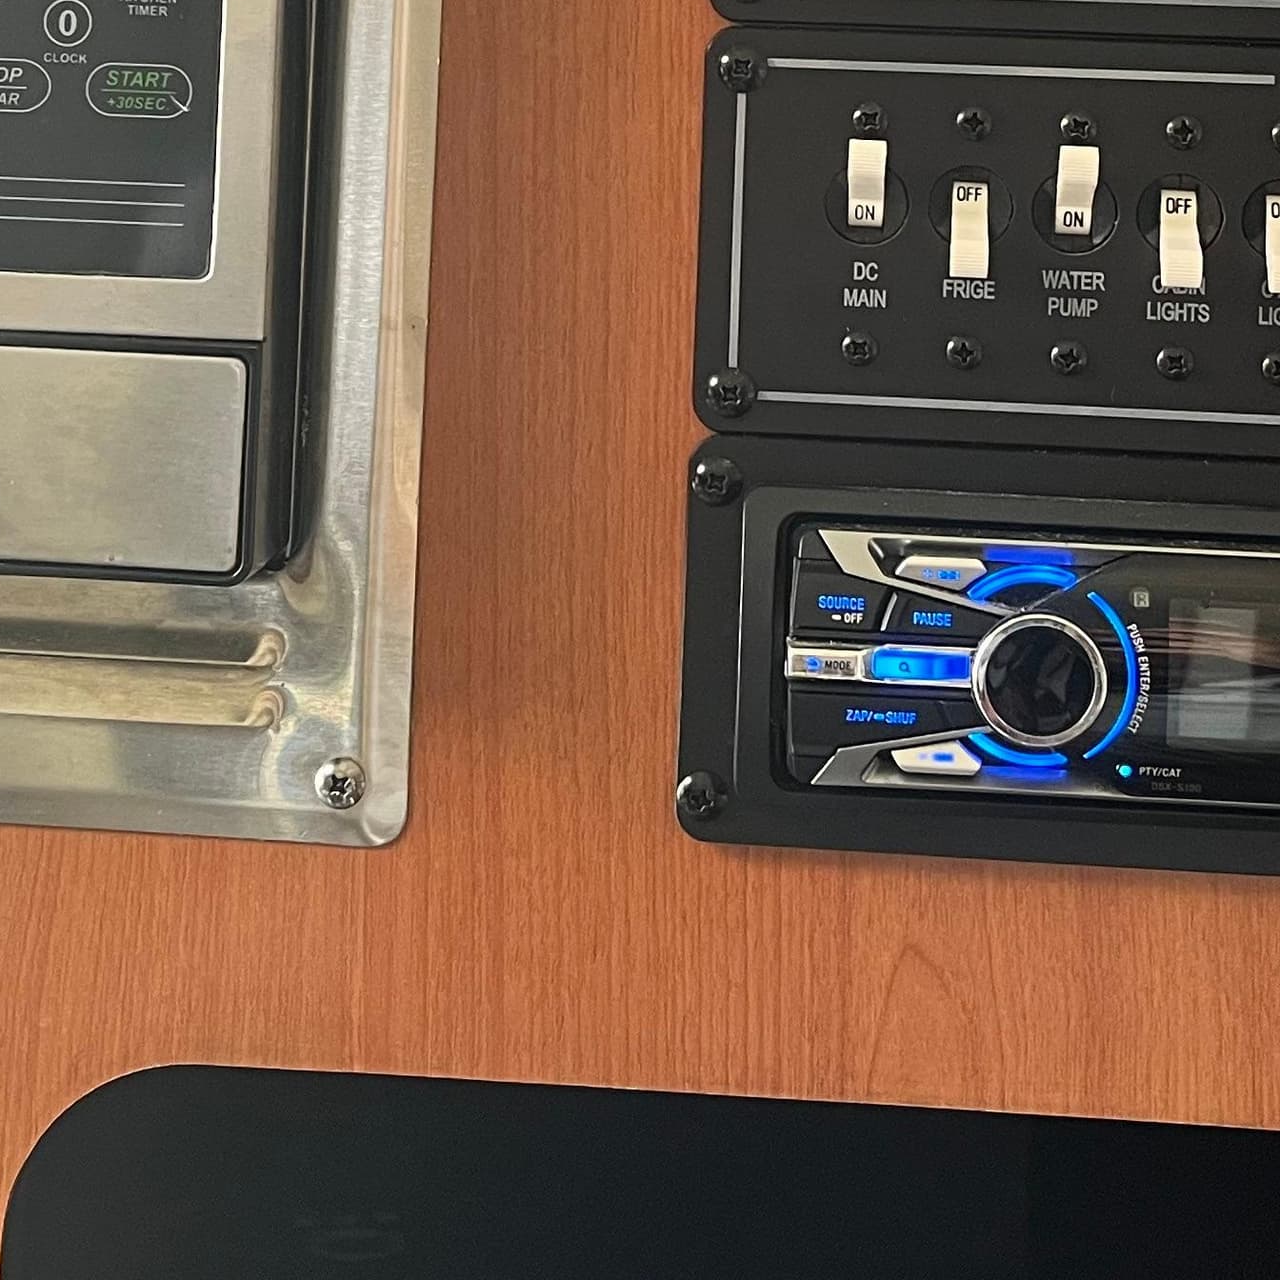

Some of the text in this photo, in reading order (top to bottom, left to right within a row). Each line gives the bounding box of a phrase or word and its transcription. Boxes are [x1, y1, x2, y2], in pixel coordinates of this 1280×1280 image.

[127, 4, 168, 17] TIMER
[58, 9, 77, 36] 0
[43, 52, 87, 64] CLOCK
[106, 70, 172, 88] START
[956, 186, 982, 203] OFF
[854, 204, 876, 221] ON
[1165, 198, 1192, 215] OFF
[1062, 211, 1084, 228] ON
[853, 261, 878, 282] DC
[942, 279, 996, 300] FRIGE
[1042, 270, 1105, 292] WATER
[843, 289, 887, 309] MAIN
[1047, 297, 1099, 318] PUMP
[1146, 301, 1210, 323] LIGHTS
[818, 595, 865, 611] SOURCE
[843, 612, 864, 624] OFF
[912, 611, 953, 627] PAUSE
[824, 659, 852, 671] MODE
[1126, 623, 1151, 735] PUSH ENTER/SELECT
[1138, 766, 1183, 779] PTY/CAT
